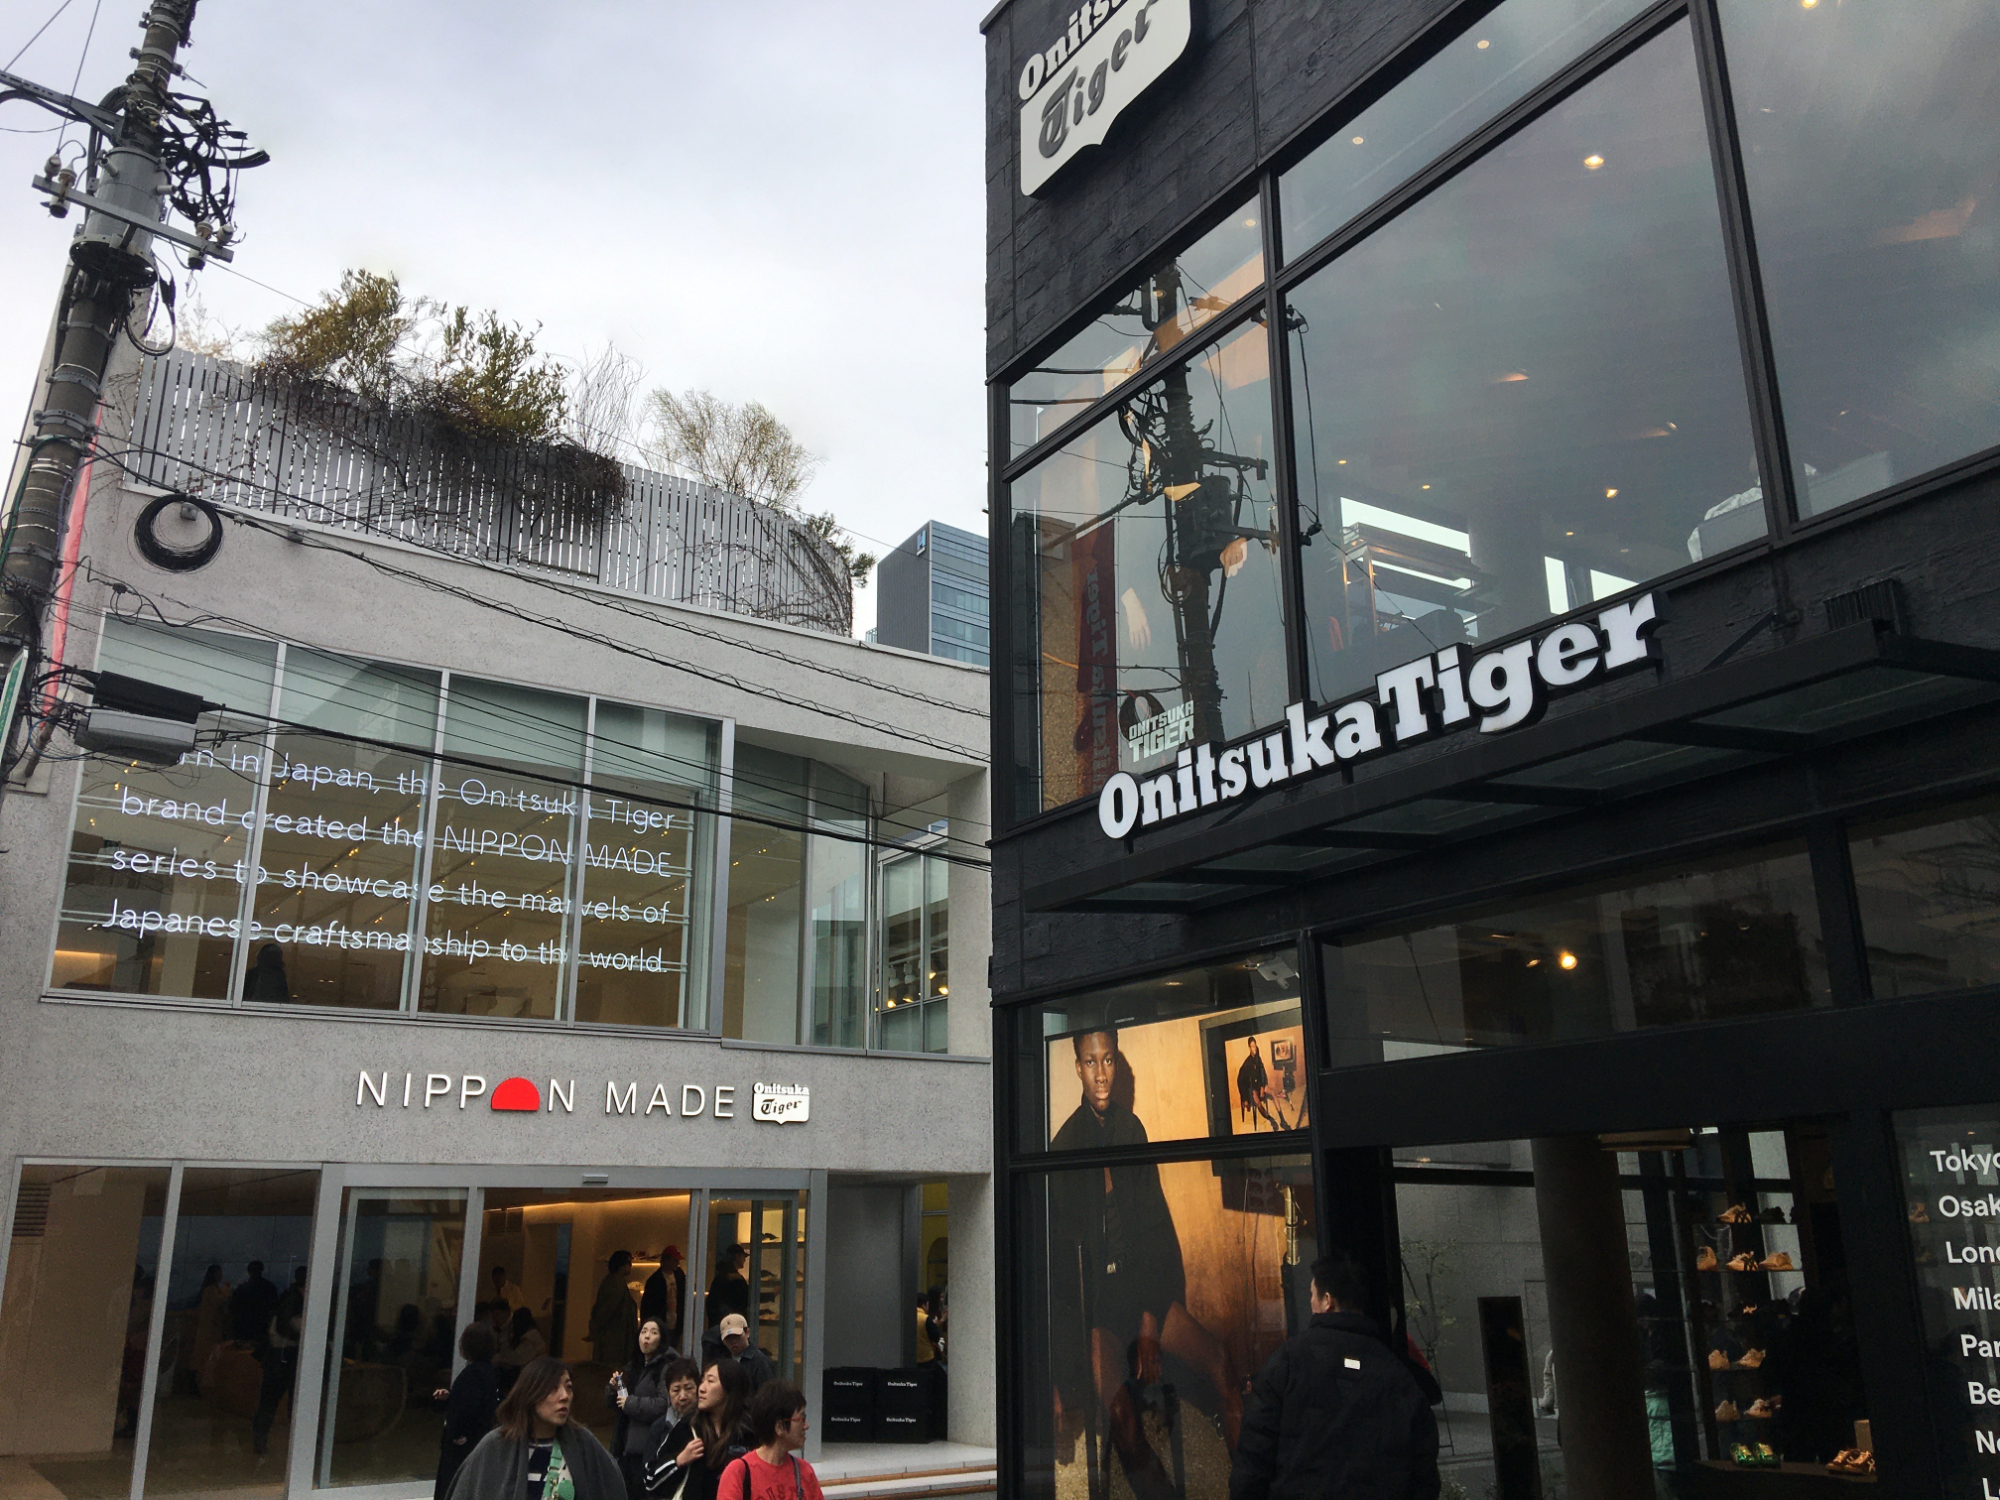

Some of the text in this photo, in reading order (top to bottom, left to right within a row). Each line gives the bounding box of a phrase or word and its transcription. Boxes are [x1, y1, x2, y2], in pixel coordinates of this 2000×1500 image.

[1019, 0, 1128, 100] Onits
[1039, 0, 1159, 158] Tiger
[1099, 592, 1657, 839] Onitsuka Tiger
[1129, 700, 1194, 740] ONITSUKA
[1129, 714, 1195, 762] TIGER
[231, 744, 260, 773] in
[275, 752, 380, 794] Japan,
[460, 779, 593, 819] Onitsuk
[605, 798, 675, 834] Tiger
[121, 786, 672, 878] brand created the NIPPON MADE
[111, 847, 217, 879] series
[234, 859, 268, 885] to
[458, 879, 507, 908] the
[643, 900, 671, 925] of
[102, 898, 262, 940] Japanese
[501, 938, 527, 962] to
[538, 939, 568, 965] th
[589, 947, 668, 973] world.
[605, 1081, 735, 1118] MADE
[754, 1082, 809, 1095] Onitsuka
[761, 1098, 802, 1115] Tiger
[1945, 1241, 2000, 1264] Lon
[1975, 1430, 2000, 1454] N
[1982, 1477, 2000, 1500] L
